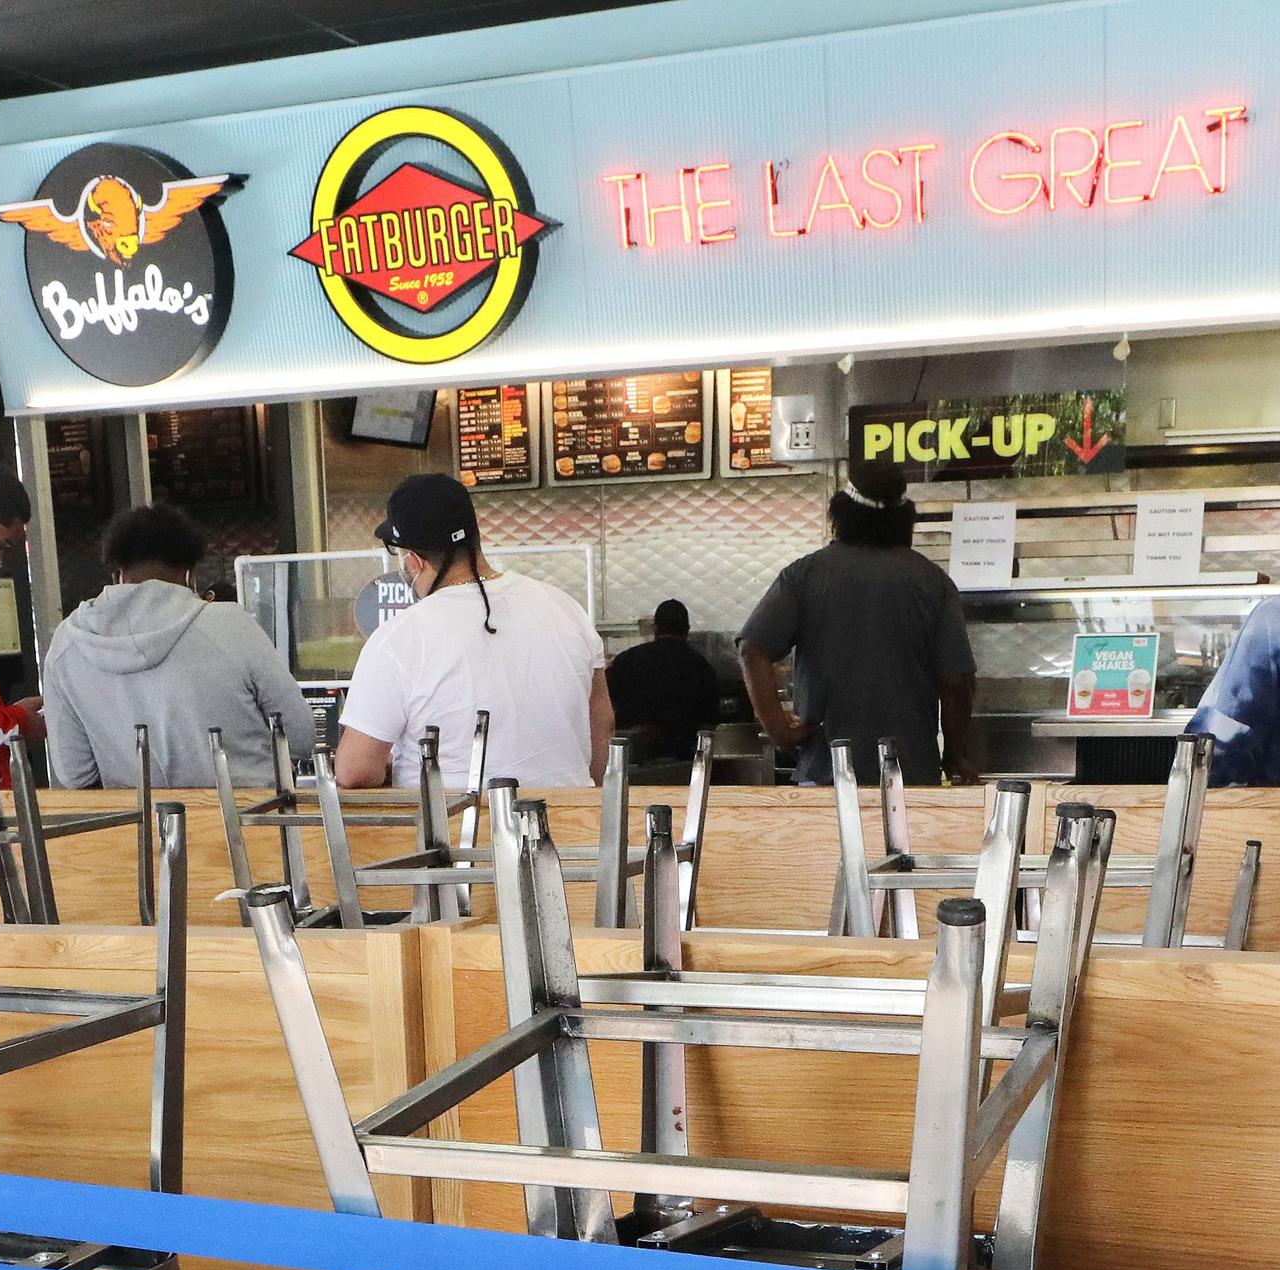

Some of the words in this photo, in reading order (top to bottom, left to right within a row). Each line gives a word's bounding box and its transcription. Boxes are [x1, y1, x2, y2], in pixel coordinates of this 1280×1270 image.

[603, 162, 736, 250] THE
[765, 143, 936, 236] LAST
[969, 104, 1248, 215] GREAT
[319, 198, 518, 276] FATBURGER
[389, 276, 420, 292] Since
[423, 271, 454, 288] 1952
[41, 264, 210, 339] Buffalo's
[864, 413, 1056, 463] PICK-UP
[378, 582, 415, 604] PICK
[1092, 660, 1135, 671] SHAKES
[1095, 651, 1133, 661] VEGAN
